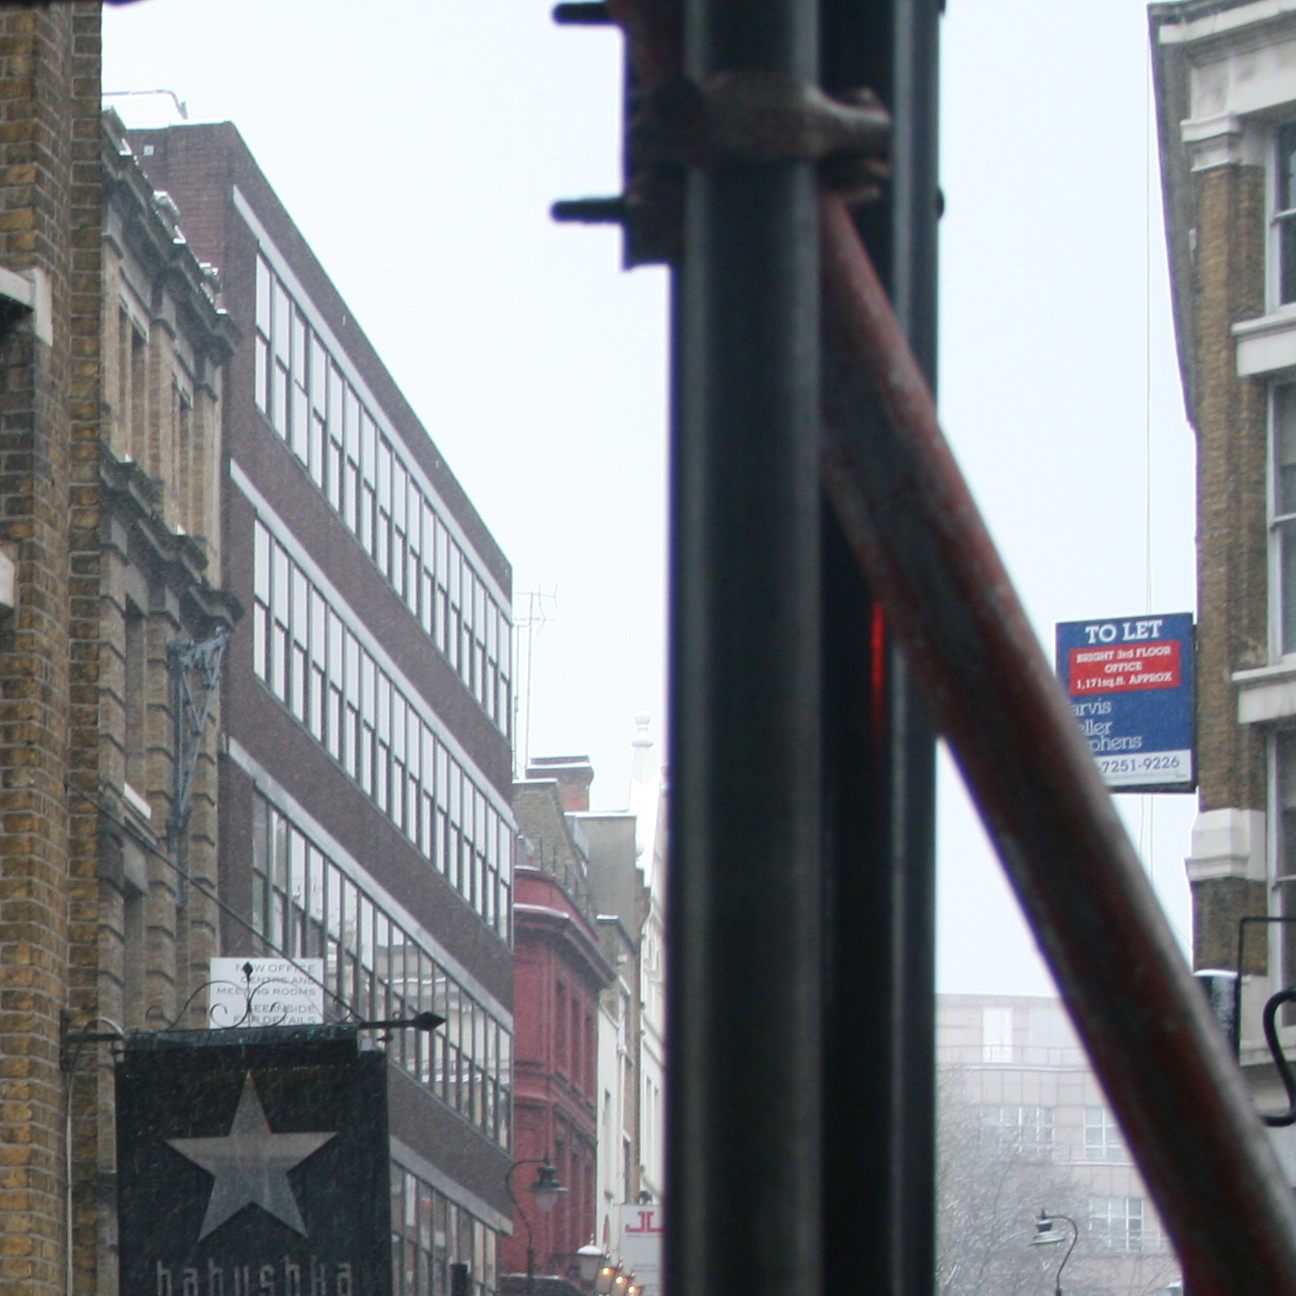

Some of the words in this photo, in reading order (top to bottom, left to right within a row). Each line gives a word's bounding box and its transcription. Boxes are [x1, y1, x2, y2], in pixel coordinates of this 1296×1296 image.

[1085, 625, 1117, 644] TO
[1122, 619, 1163, 641] LET
[1076, 650, 1115, 663] BRIGHT
[1117, 648, 1134, 660] 3rd
[1135, 645, 1172, 658] FLOOR
[1104, 661, 1143, 674] OFFICE
[1129, 671, 1173, 685] APPROX
[1070, 697, 1112, 716] arvis
[1089, 735, 1143, 752] phens
